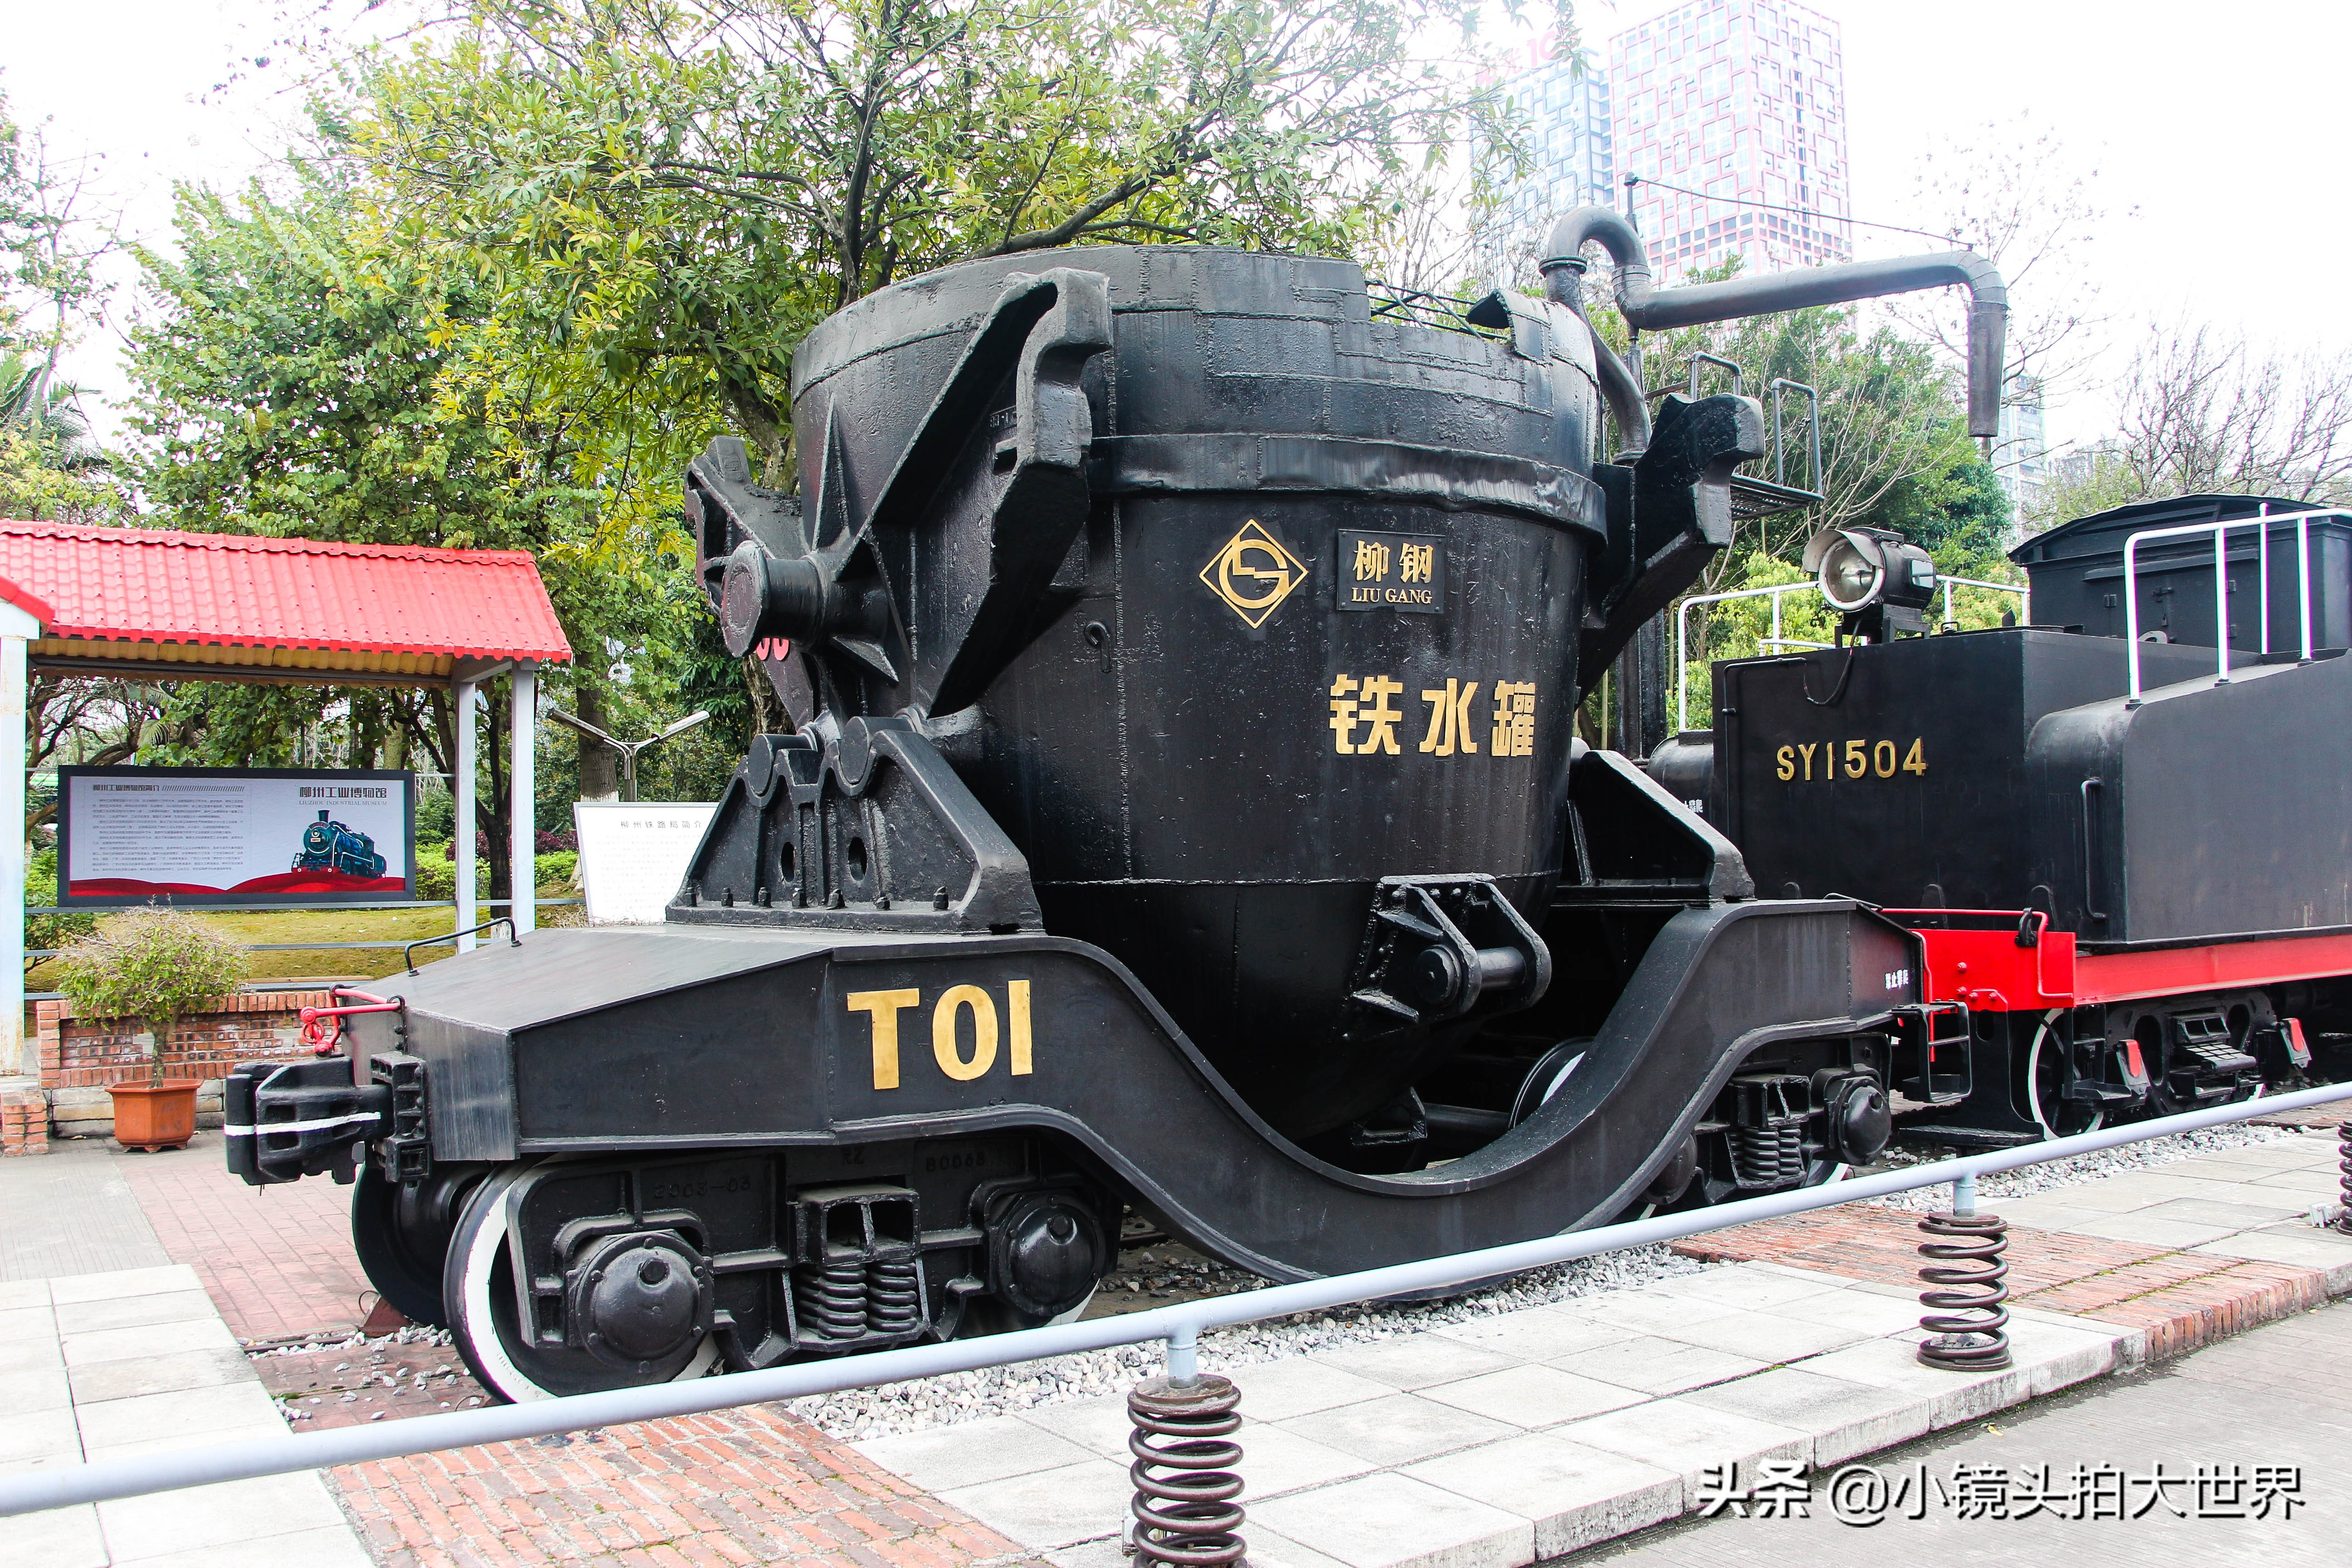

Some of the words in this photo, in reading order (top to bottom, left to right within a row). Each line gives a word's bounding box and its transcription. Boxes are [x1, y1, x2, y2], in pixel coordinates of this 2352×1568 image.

[1352, 540, 1434, 583] 柳钢
[1352, 588, 1381, 602] LIU
[1385, 588, 1432, 604] GANG
[1328, 673, 1537, 757] 铁水罐
[1776, 737, 1927, 781] SY1504
[299, 786, 387, 799] 柳州工业博物馆
[620, 820, 702, 829] 柳州铁路局简介
[847, 980, 1033, 1090] T01
